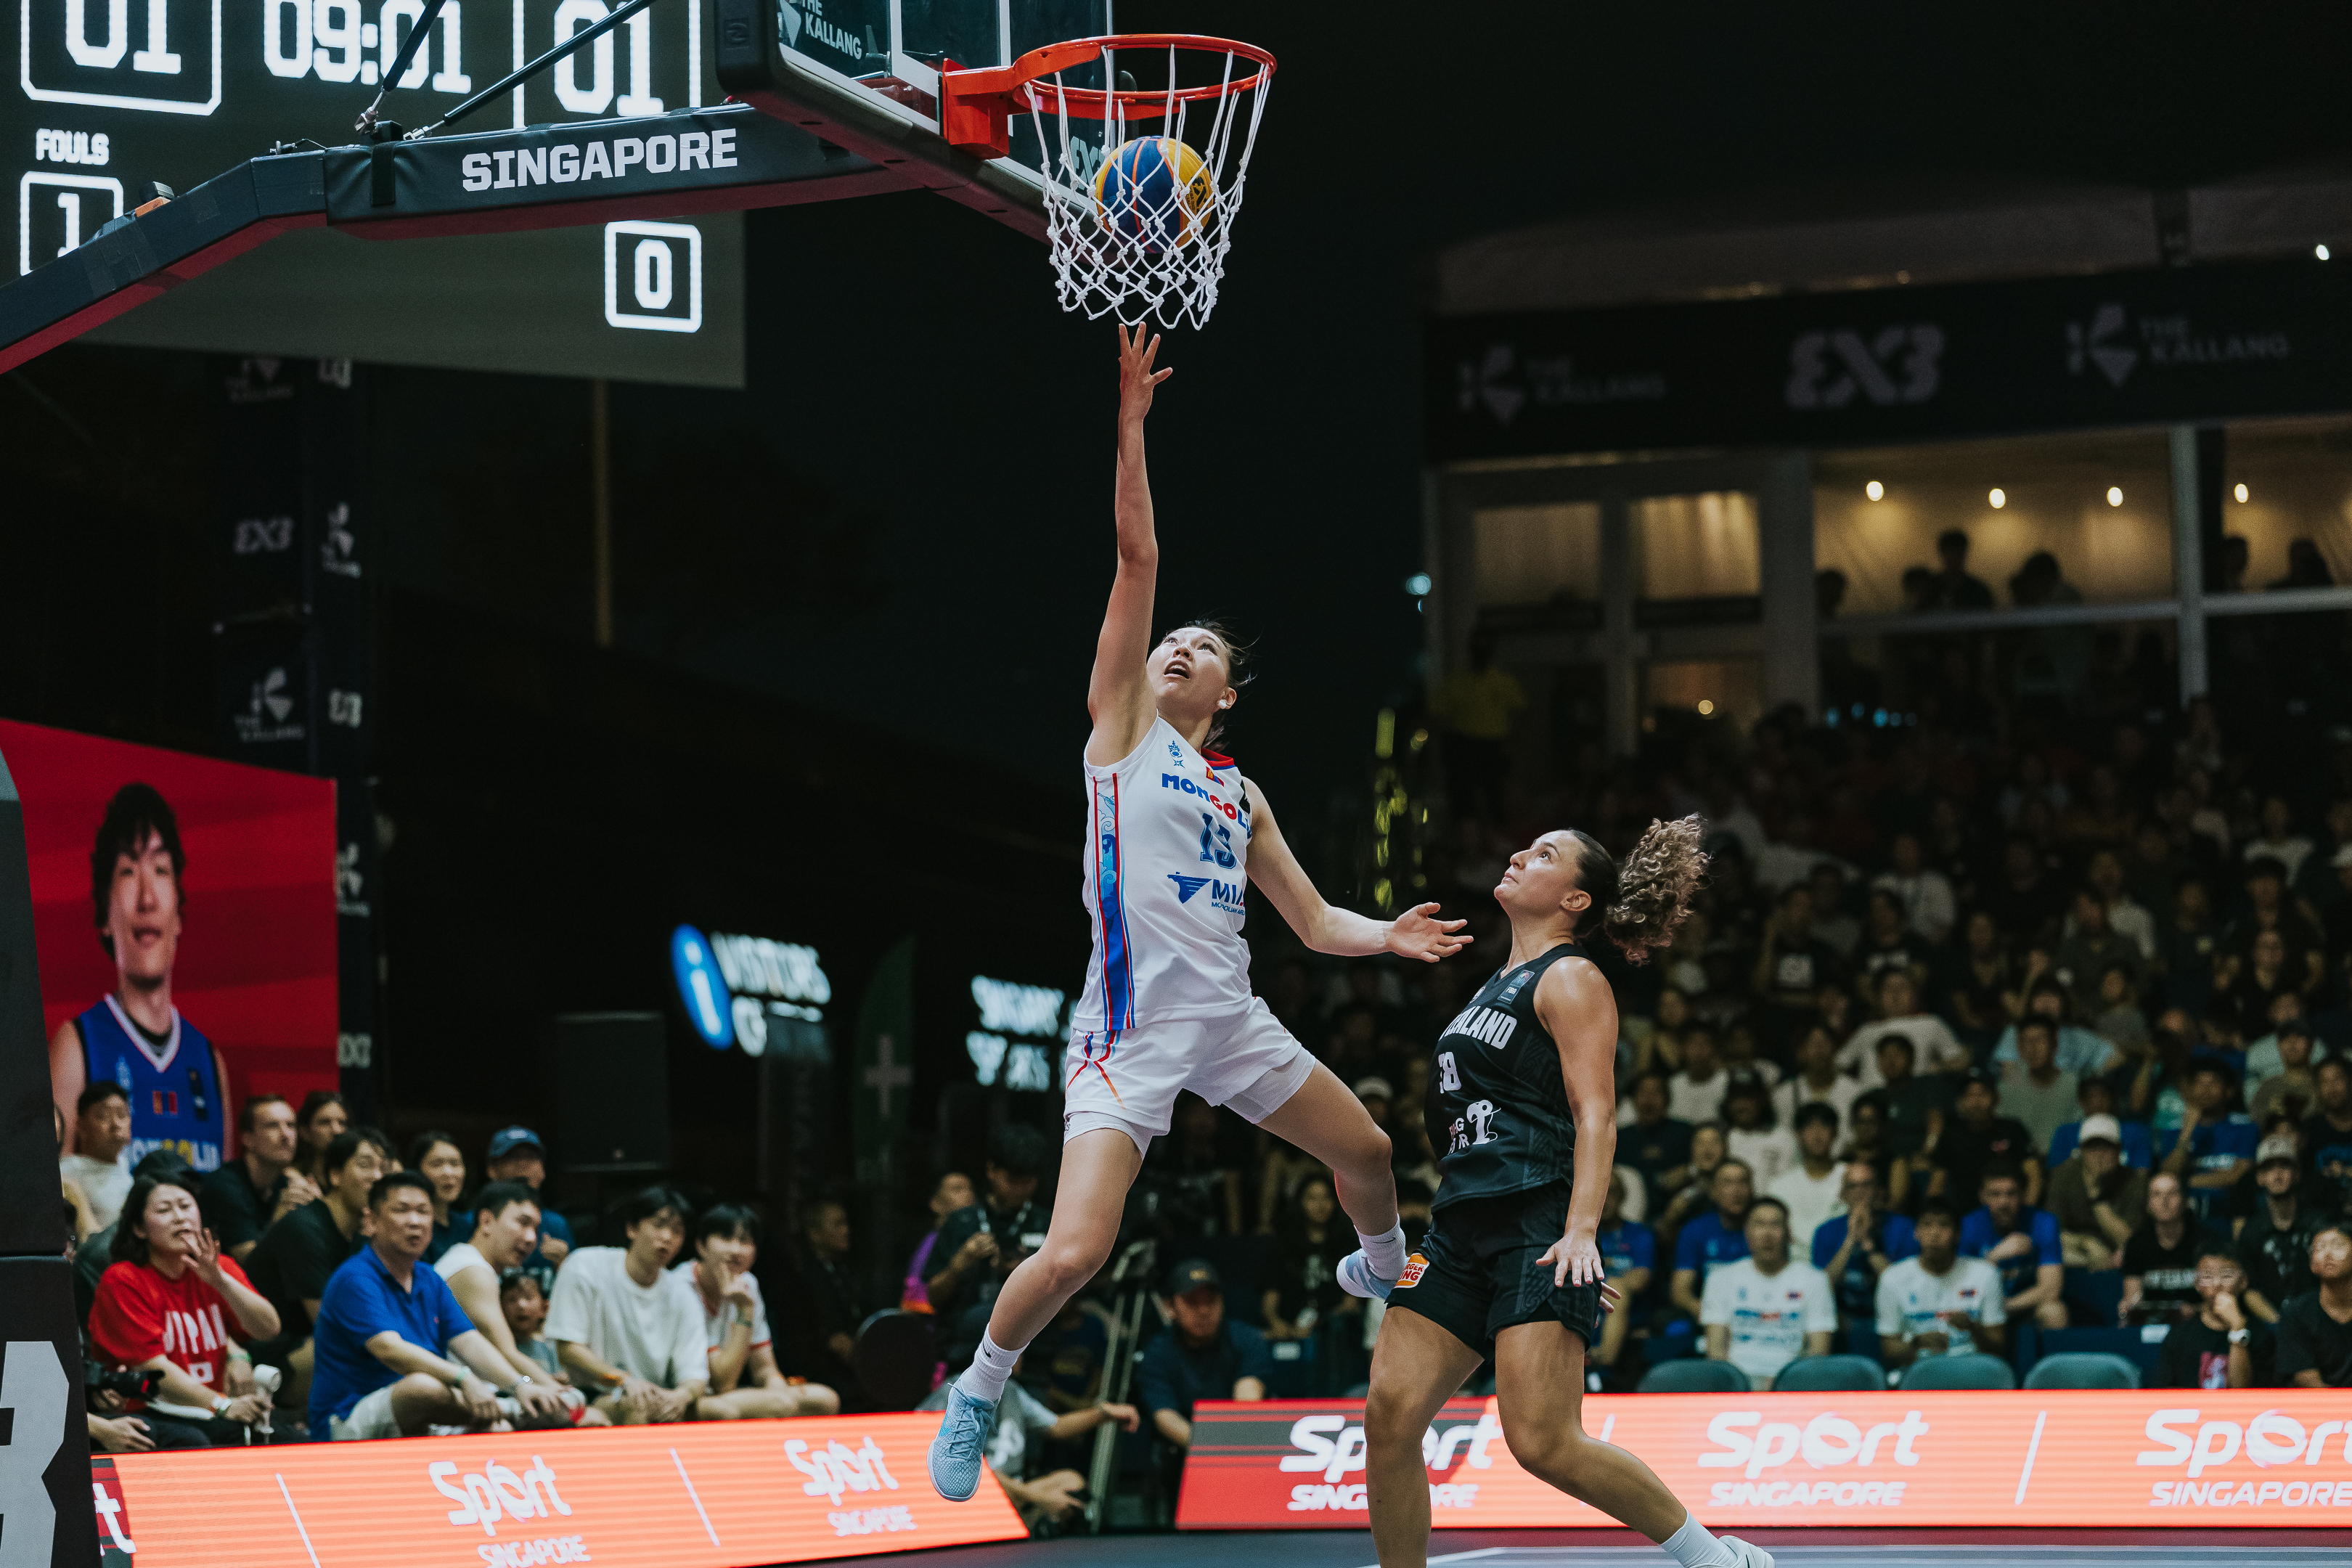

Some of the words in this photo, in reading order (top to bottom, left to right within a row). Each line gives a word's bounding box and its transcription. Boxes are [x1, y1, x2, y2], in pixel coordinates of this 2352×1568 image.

[65, 0, 181, 74] 01
[264, 0, 472, 94] 09:01
[554, 0, 663, 116] 01
[805, 12, 862, 60] KALLANG
[36, 128, 109, 166] FOULS
[462, 128, 738, 192] SINGAPORE
[57, 192, 80, 258] 1
[634, 239, 672, 310] 0
[1161, 772, 1251, 839] MONGOL
[783, 1435, 899, 1507] Sport
[1278, 1414, 1503, 1483] Sprt
[1697, 1410, 1930, 1479] Sport
[428, 1454, 573, 1537] Sport
[1287, 1483, 1479, 1511] SINGRE
[1707, 1481, 1908, 1507] SINGAPORE
[2149, 1481, 2352, 1507] SINGAPORE
[477, 1534, 592, 1568] SINGAPORE
